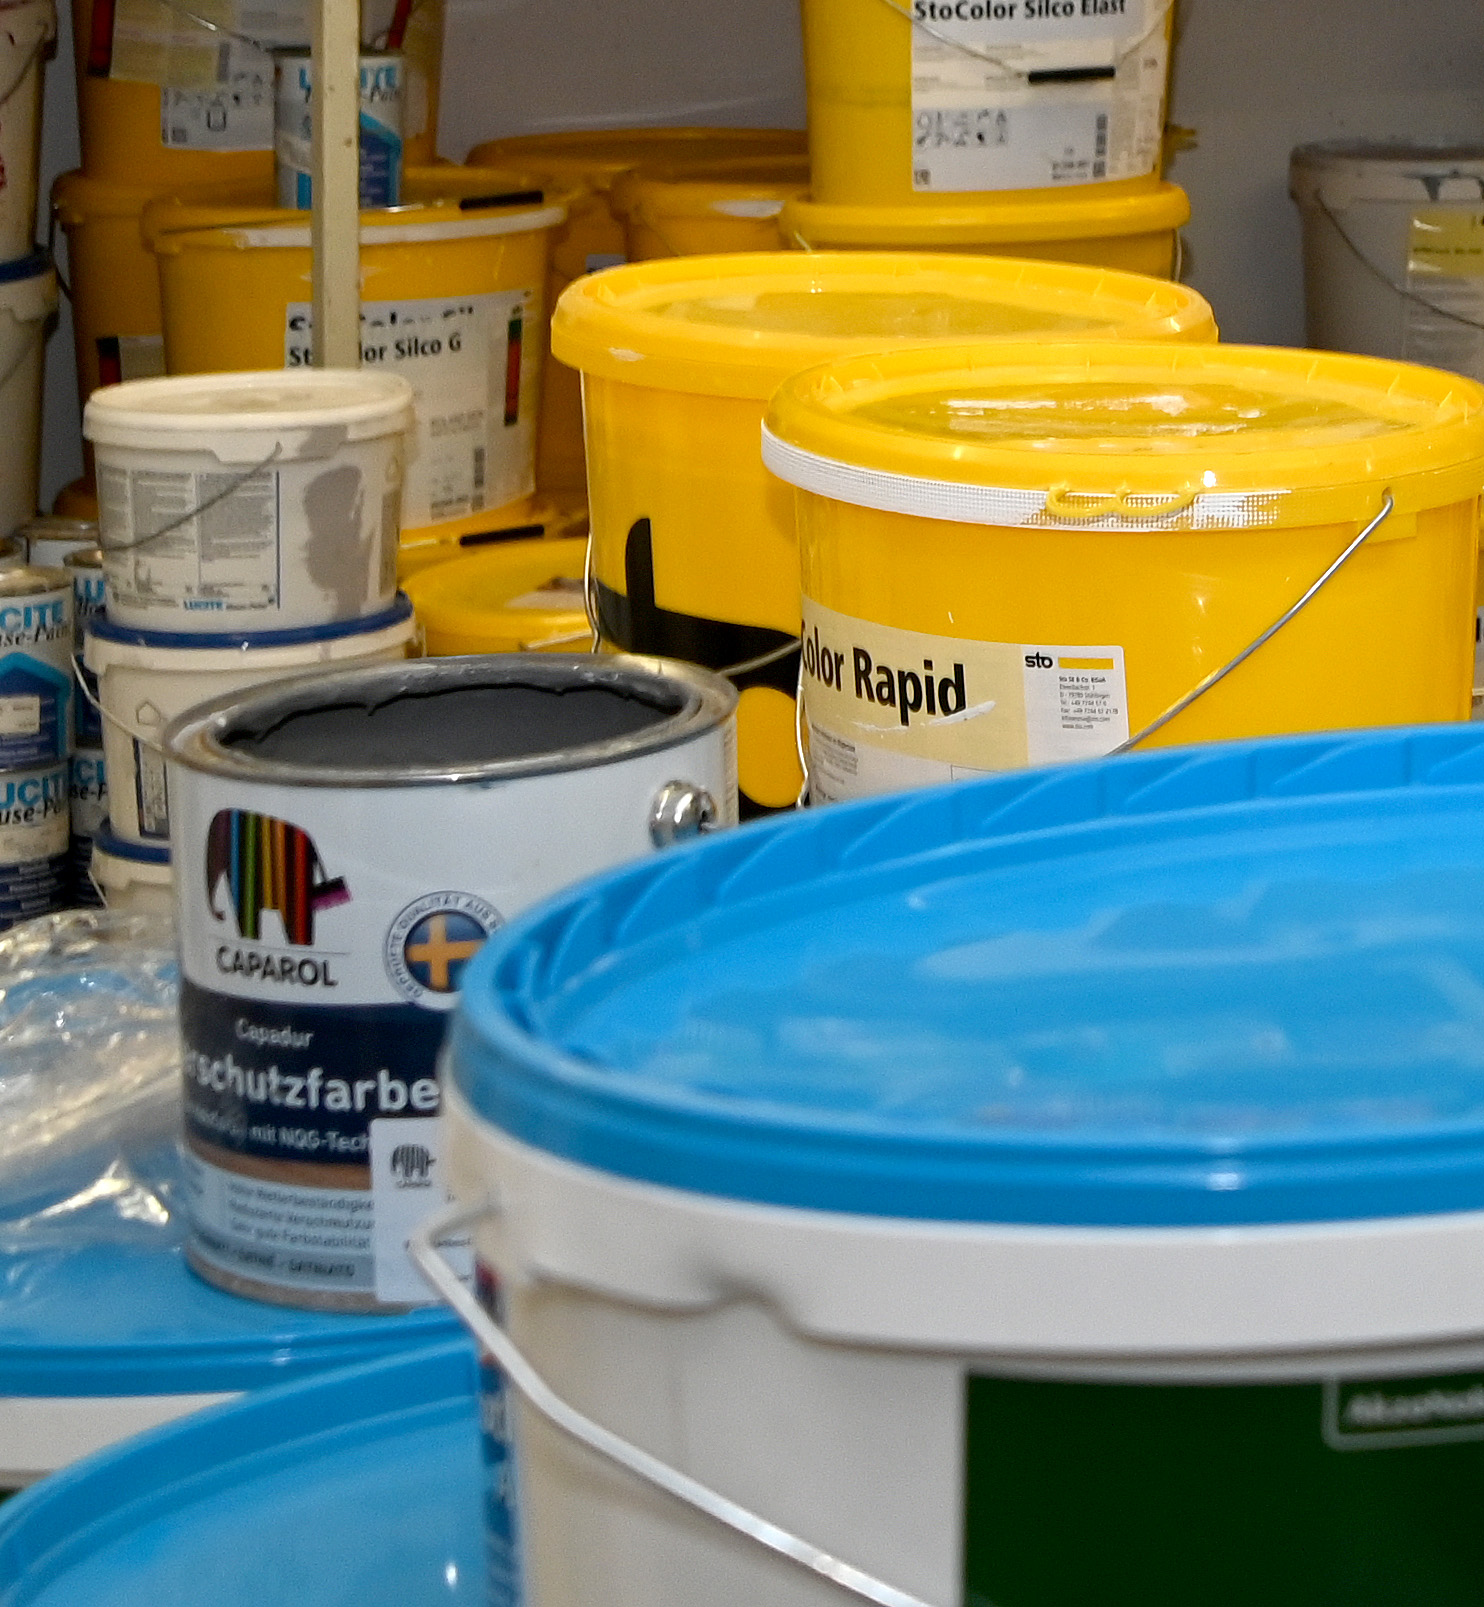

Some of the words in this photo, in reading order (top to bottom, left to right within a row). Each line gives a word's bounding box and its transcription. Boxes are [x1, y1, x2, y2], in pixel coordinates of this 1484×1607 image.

[914, 0, 1018, 22] StoColor
[289, 340, 388, 367] Stlor
[394, 335, 443, 359] Silco
[448, 332, 462, 353] G
[0, 600, 64, 630] CITE
[1024, 651, 1053, 669] sto
[852, 646, 968, 726] Rapid
[216, 944, 338, 988] CAPAROL
[235, 1016, 314, 1049] Capadur
[186, 1048, 439, 1112] schutzfarbe
